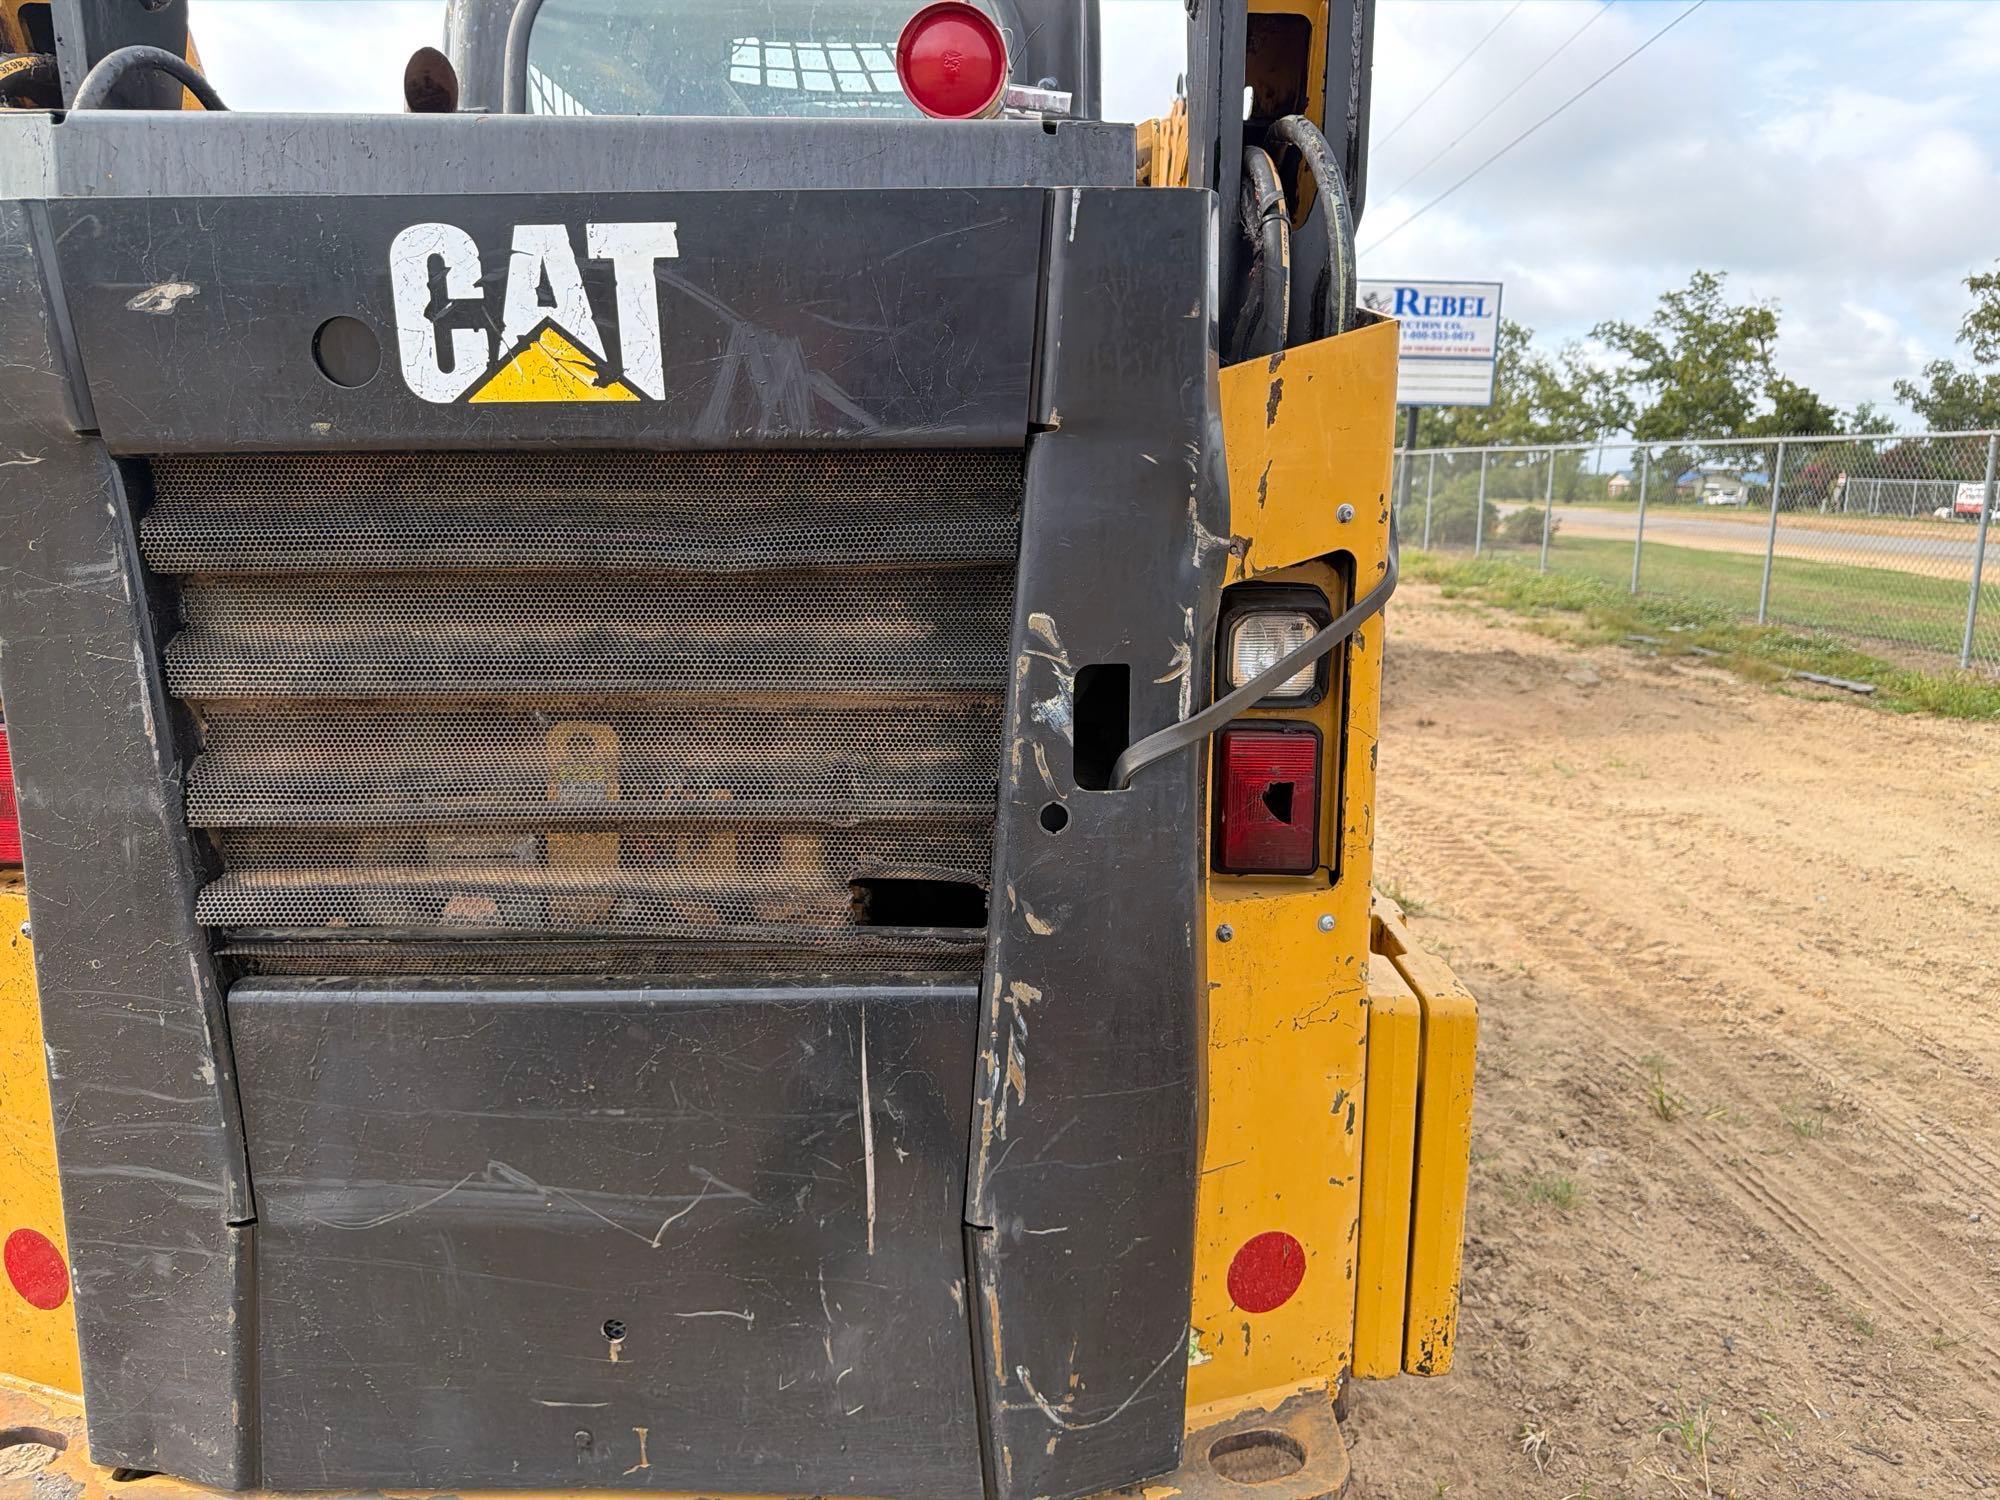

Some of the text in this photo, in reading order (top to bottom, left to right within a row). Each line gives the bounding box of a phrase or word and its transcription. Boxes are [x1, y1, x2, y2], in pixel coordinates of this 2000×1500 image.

[389, 222, 679, 404] CAT
[1394, 287, 1493, 318] REBEL
[1401, 319, 1441, 330] CTION
